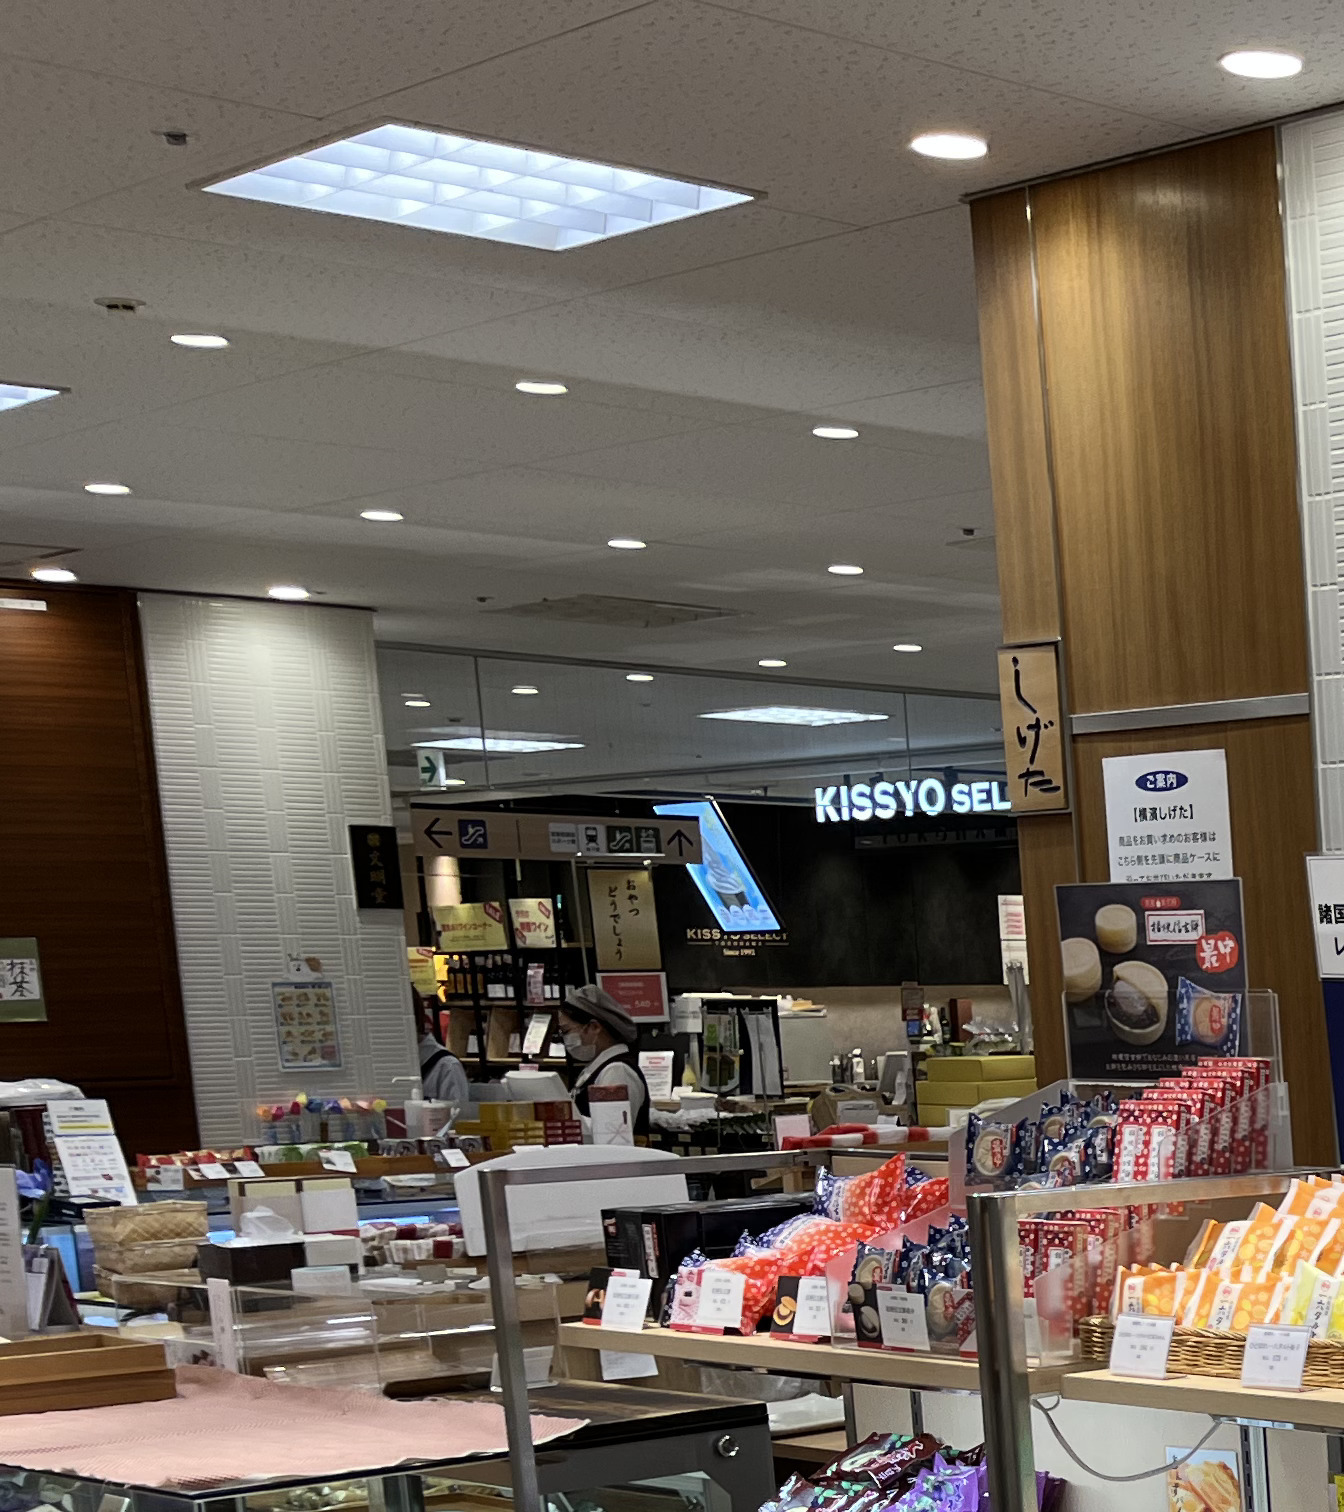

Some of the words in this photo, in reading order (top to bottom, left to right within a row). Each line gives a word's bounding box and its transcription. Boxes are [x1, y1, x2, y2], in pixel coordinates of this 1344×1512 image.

[1012, 656, 1061, 797] しげた
[1145, 773, 1178, 789] ご案内
[815, 778, 946, 823] KISSYO
[952, 781, 1012, 813] SEL
[626, 879, 640, 917] おやつ
[1200, 936, 1235, 969] 最中
